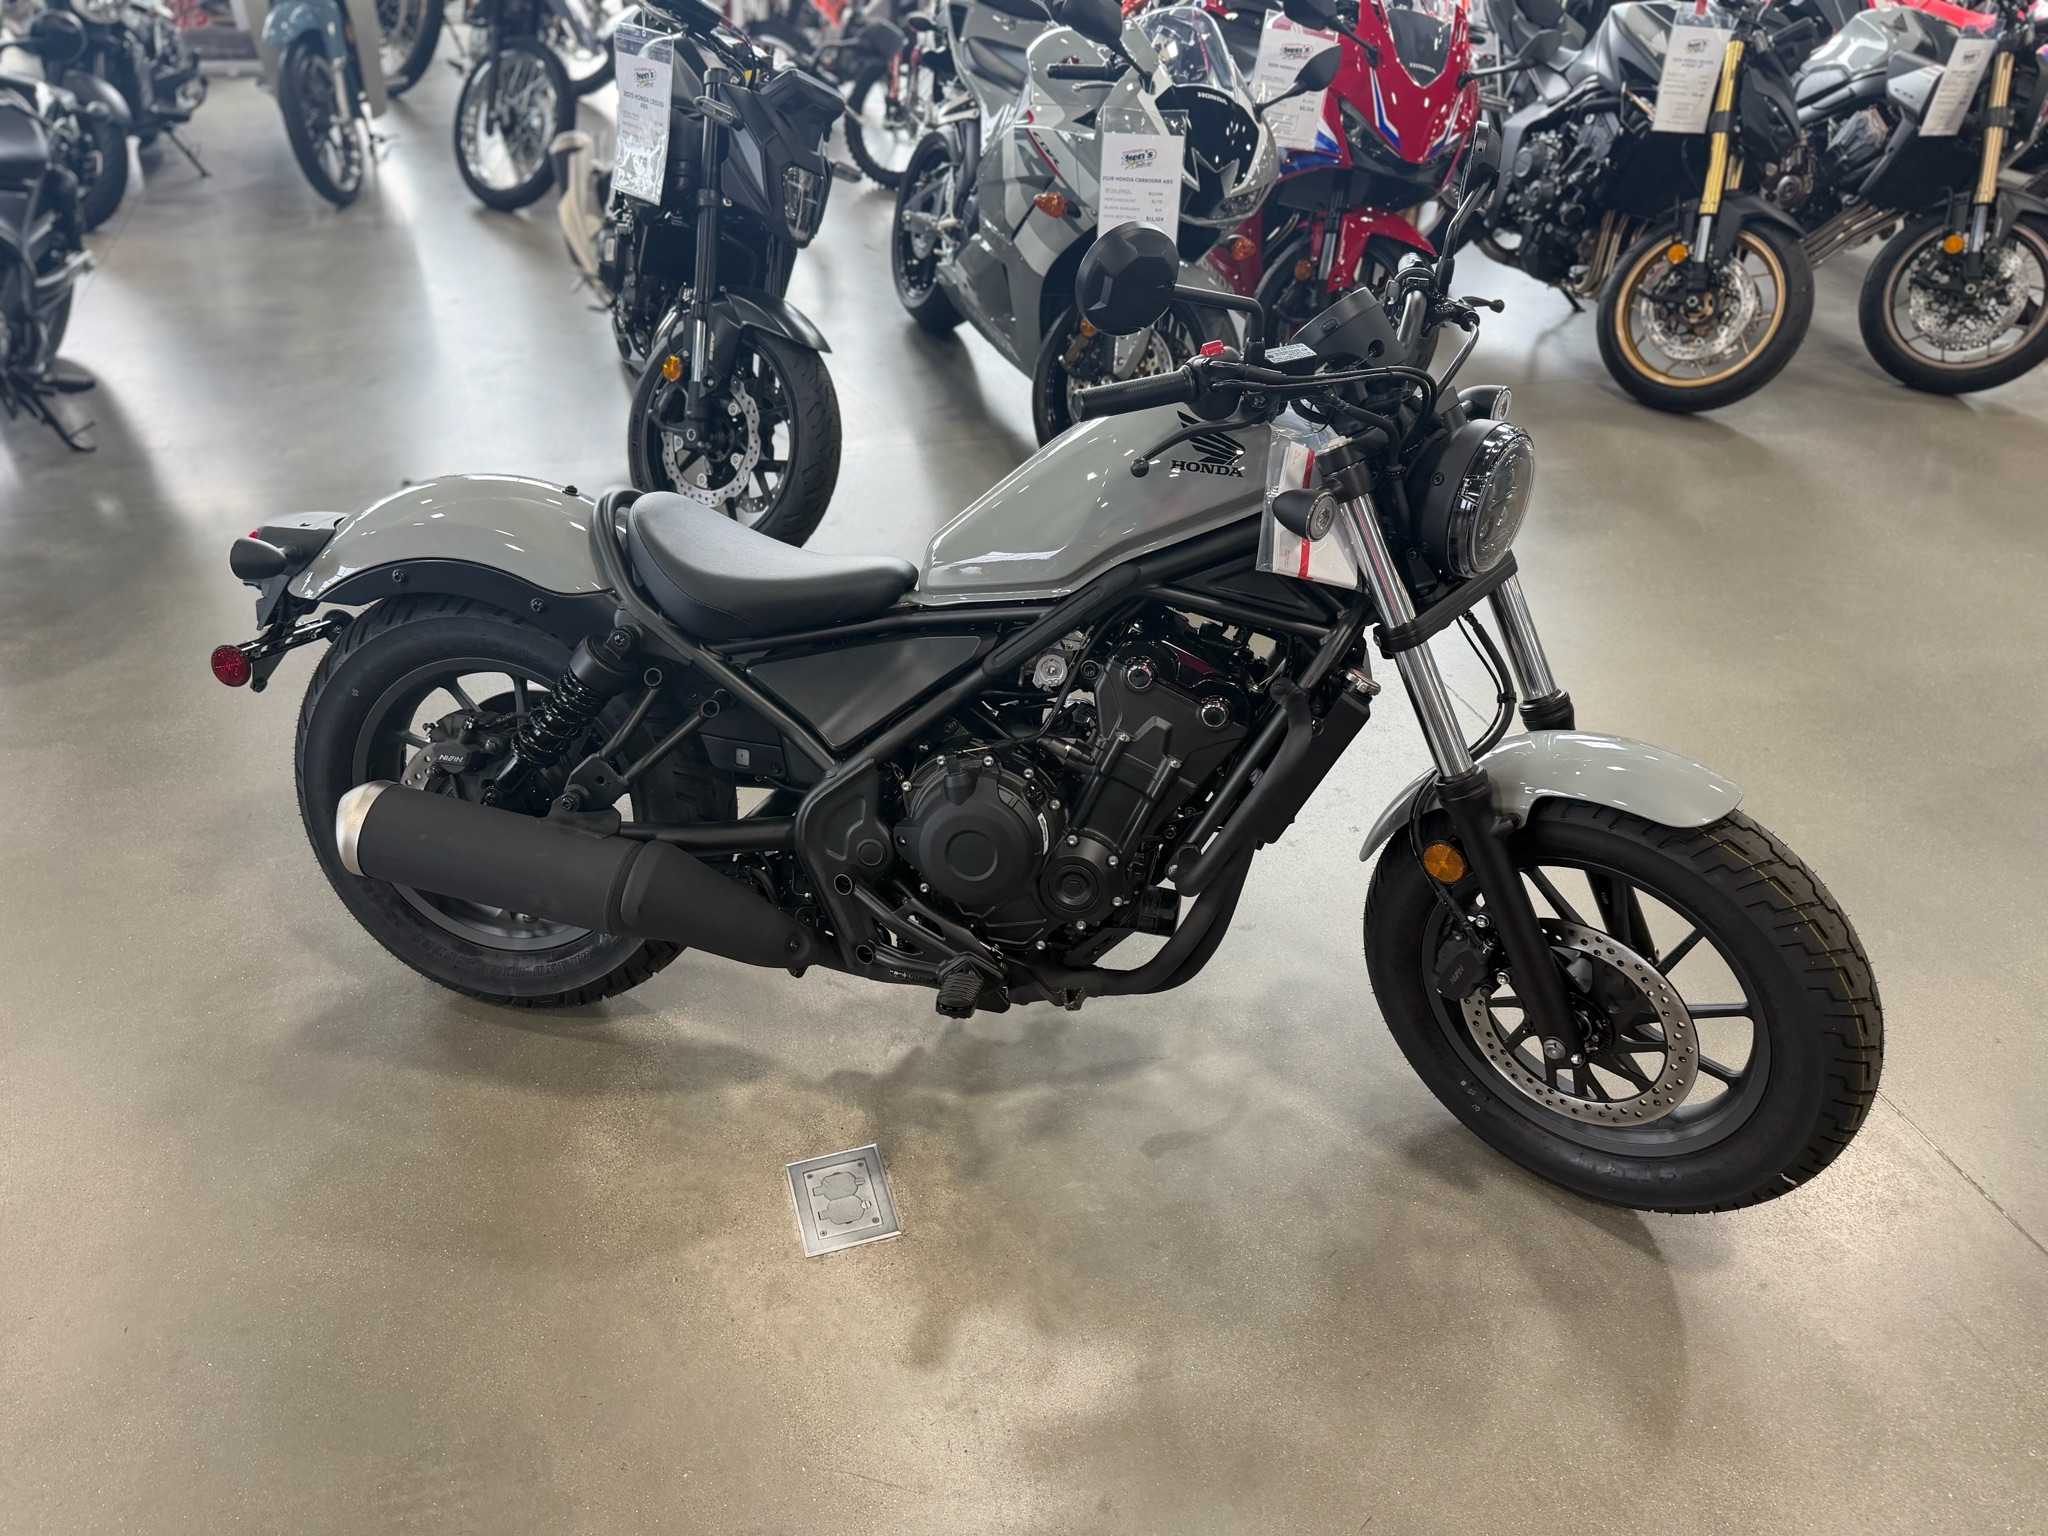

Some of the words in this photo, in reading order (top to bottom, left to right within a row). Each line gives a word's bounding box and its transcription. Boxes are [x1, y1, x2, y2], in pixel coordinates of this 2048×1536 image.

[1409, 62, 1437, 74] HONDA
[634, 94, 649, 103] HONDA
[1197, 91, 1228, 105] HONDA
[640, 102, 649, 110] ABS
[1170, 460, 1244, 478] HONDA
